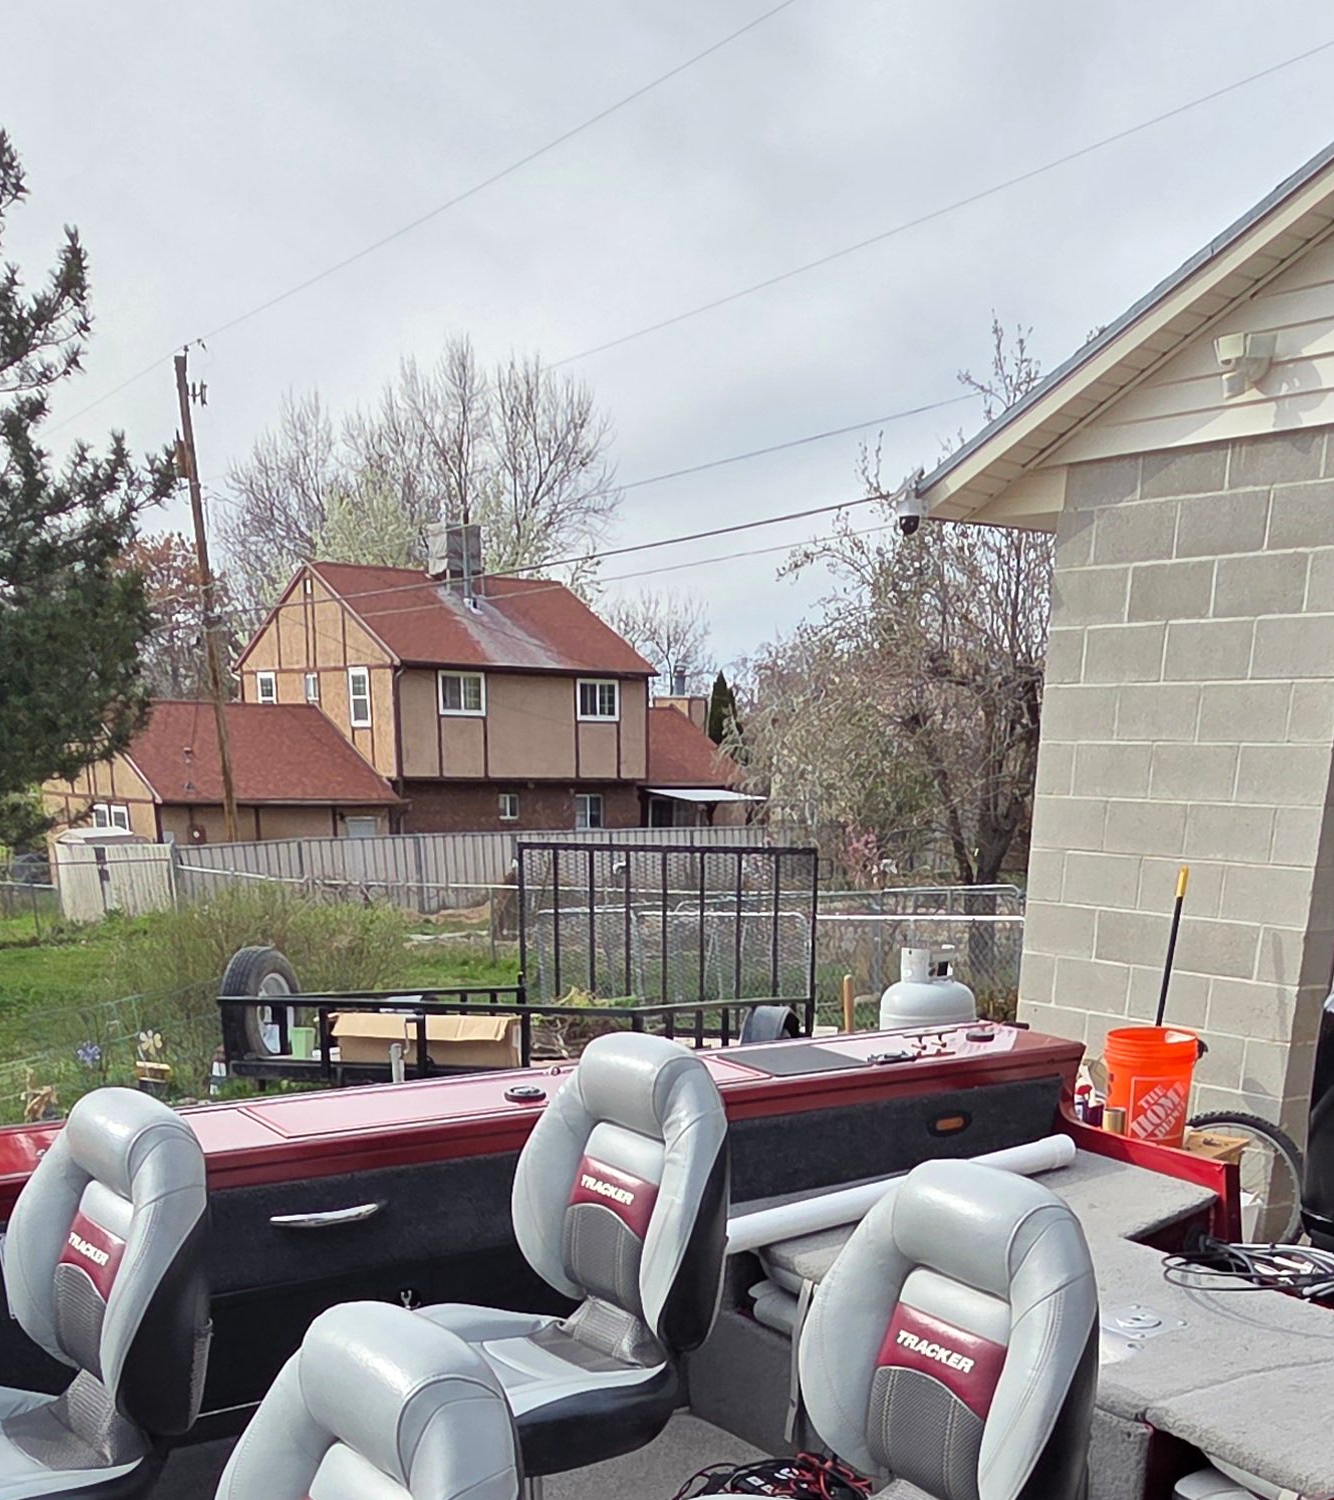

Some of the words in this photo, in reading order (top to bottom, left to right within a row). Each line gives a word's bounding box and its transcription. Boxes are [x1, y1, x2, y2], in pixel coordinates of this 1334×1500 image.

[1137, 1084, 1167, 1110] THE
[581, 1174, 635, 1206] TRACKER
[67, 1231, 110, 1267] TRACKER
[896, 1329, 975, 1374] TRACKER
